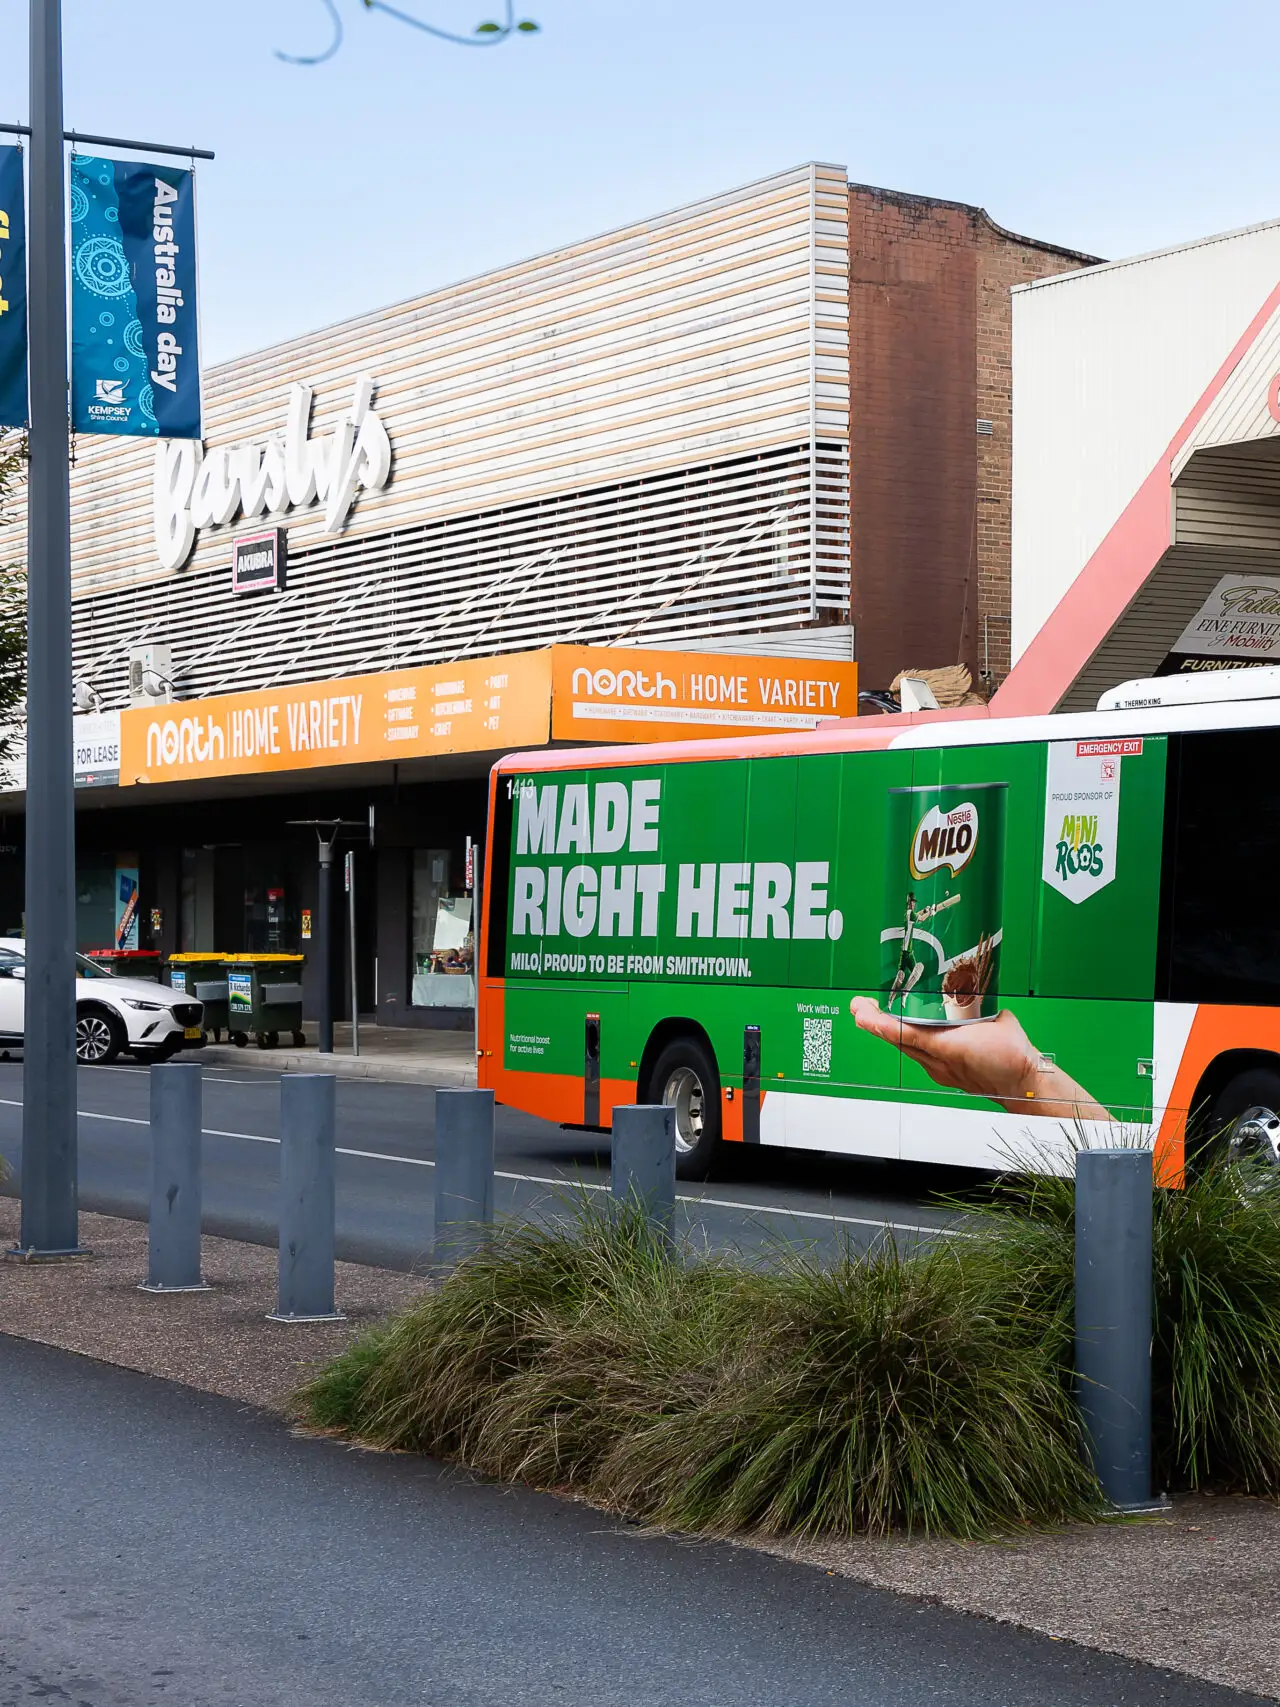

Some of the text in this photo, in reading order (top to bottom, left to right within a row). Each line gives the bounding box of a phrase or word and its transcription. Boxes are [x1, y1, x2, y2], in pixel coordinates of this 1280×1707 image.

[150, 178, 184, 392] Australia day
[88, 405, 131, 416] KEMPSEY
[237, 549, 274, 573] AKUBRA
[1197, 619, 1232, 634] FINE
[1223, 634, 1279, 651] Mobility
[691, 676, 748, 705] HOME
[759, 676, 840, 709] VARIETY
[233, 704, 280, 758] HOME
[287, 694, 363, 756] VARIETY
[77, 745, 119, 765] FOR LEASE
[1079, 742, 1140, 754] EMERGENCY EXIT
[1052, 791, 1113, 801] PROUD SPONSOR OF
[516, 779, 661, 854] MADE
[918, 824, 972, 862] MILO
[1055, 840, 1103, 882] ROOS
[512, 861, 843, 940] RIGHT HERE.
[544, 953, 586, 973] PROUD
[589, 955, 604, 973] TO
[607, 955, 624, 973] BE
[627, 955, 664, 974] FROM
[666, 956, 752, 978] SMITHTOWN.
[797, 1003, 840, 1015] Work with us
[510, 1034, 551, 1045] Nutritional boost
[517, 1045, 532, 1054] active
[533, 1046, 544, 1055] lives
